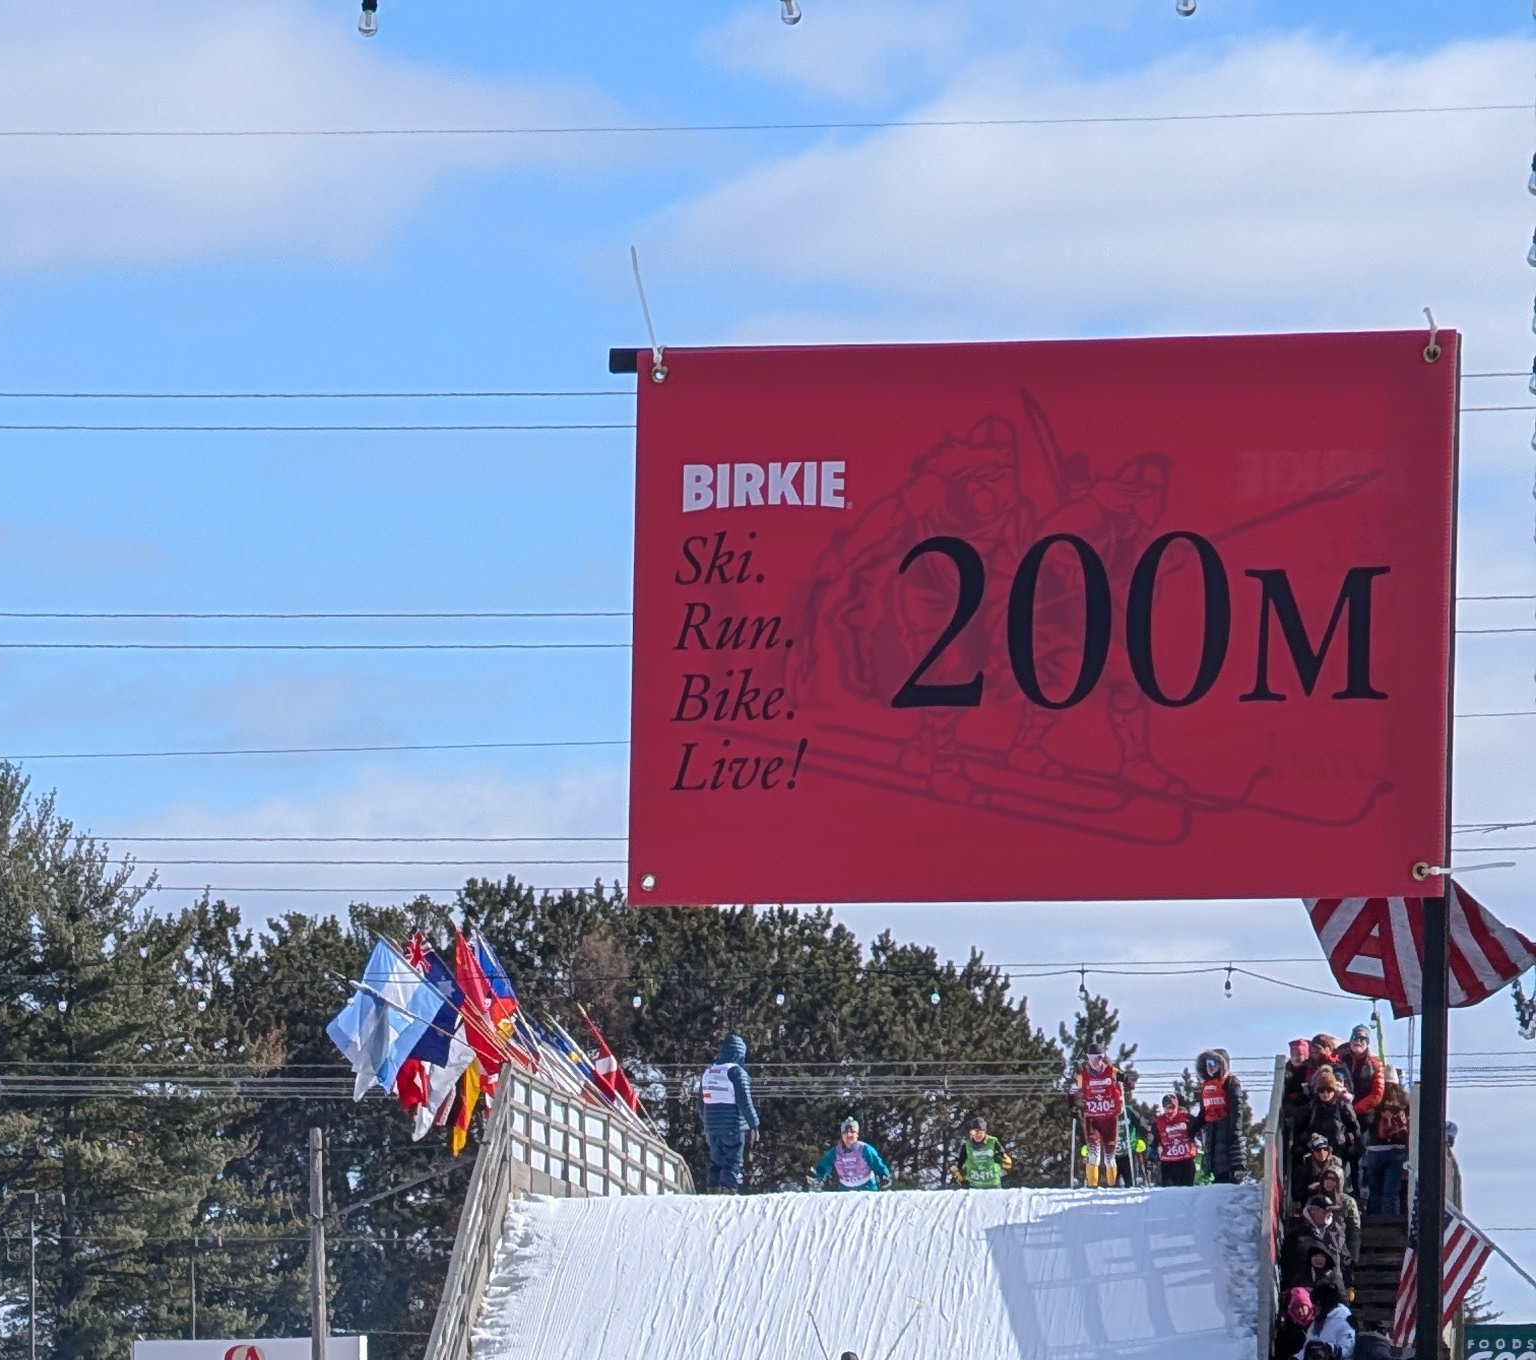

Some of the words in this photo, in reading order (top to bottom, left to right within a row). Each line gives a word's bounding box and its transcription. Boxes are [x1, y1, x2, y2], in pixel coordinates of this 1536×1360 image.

[682, 461, 846, 513] BIRKIE
[674, 531, 765, 586] Ski.
[672, 602, 795, 651] Run.
[891, 530, 1391, 710] 200M
[671, 667, 795, 722] Bike.
[669, 737, 808, 791] Live!
[1467, 1338, 1536, 1350] FOODS
